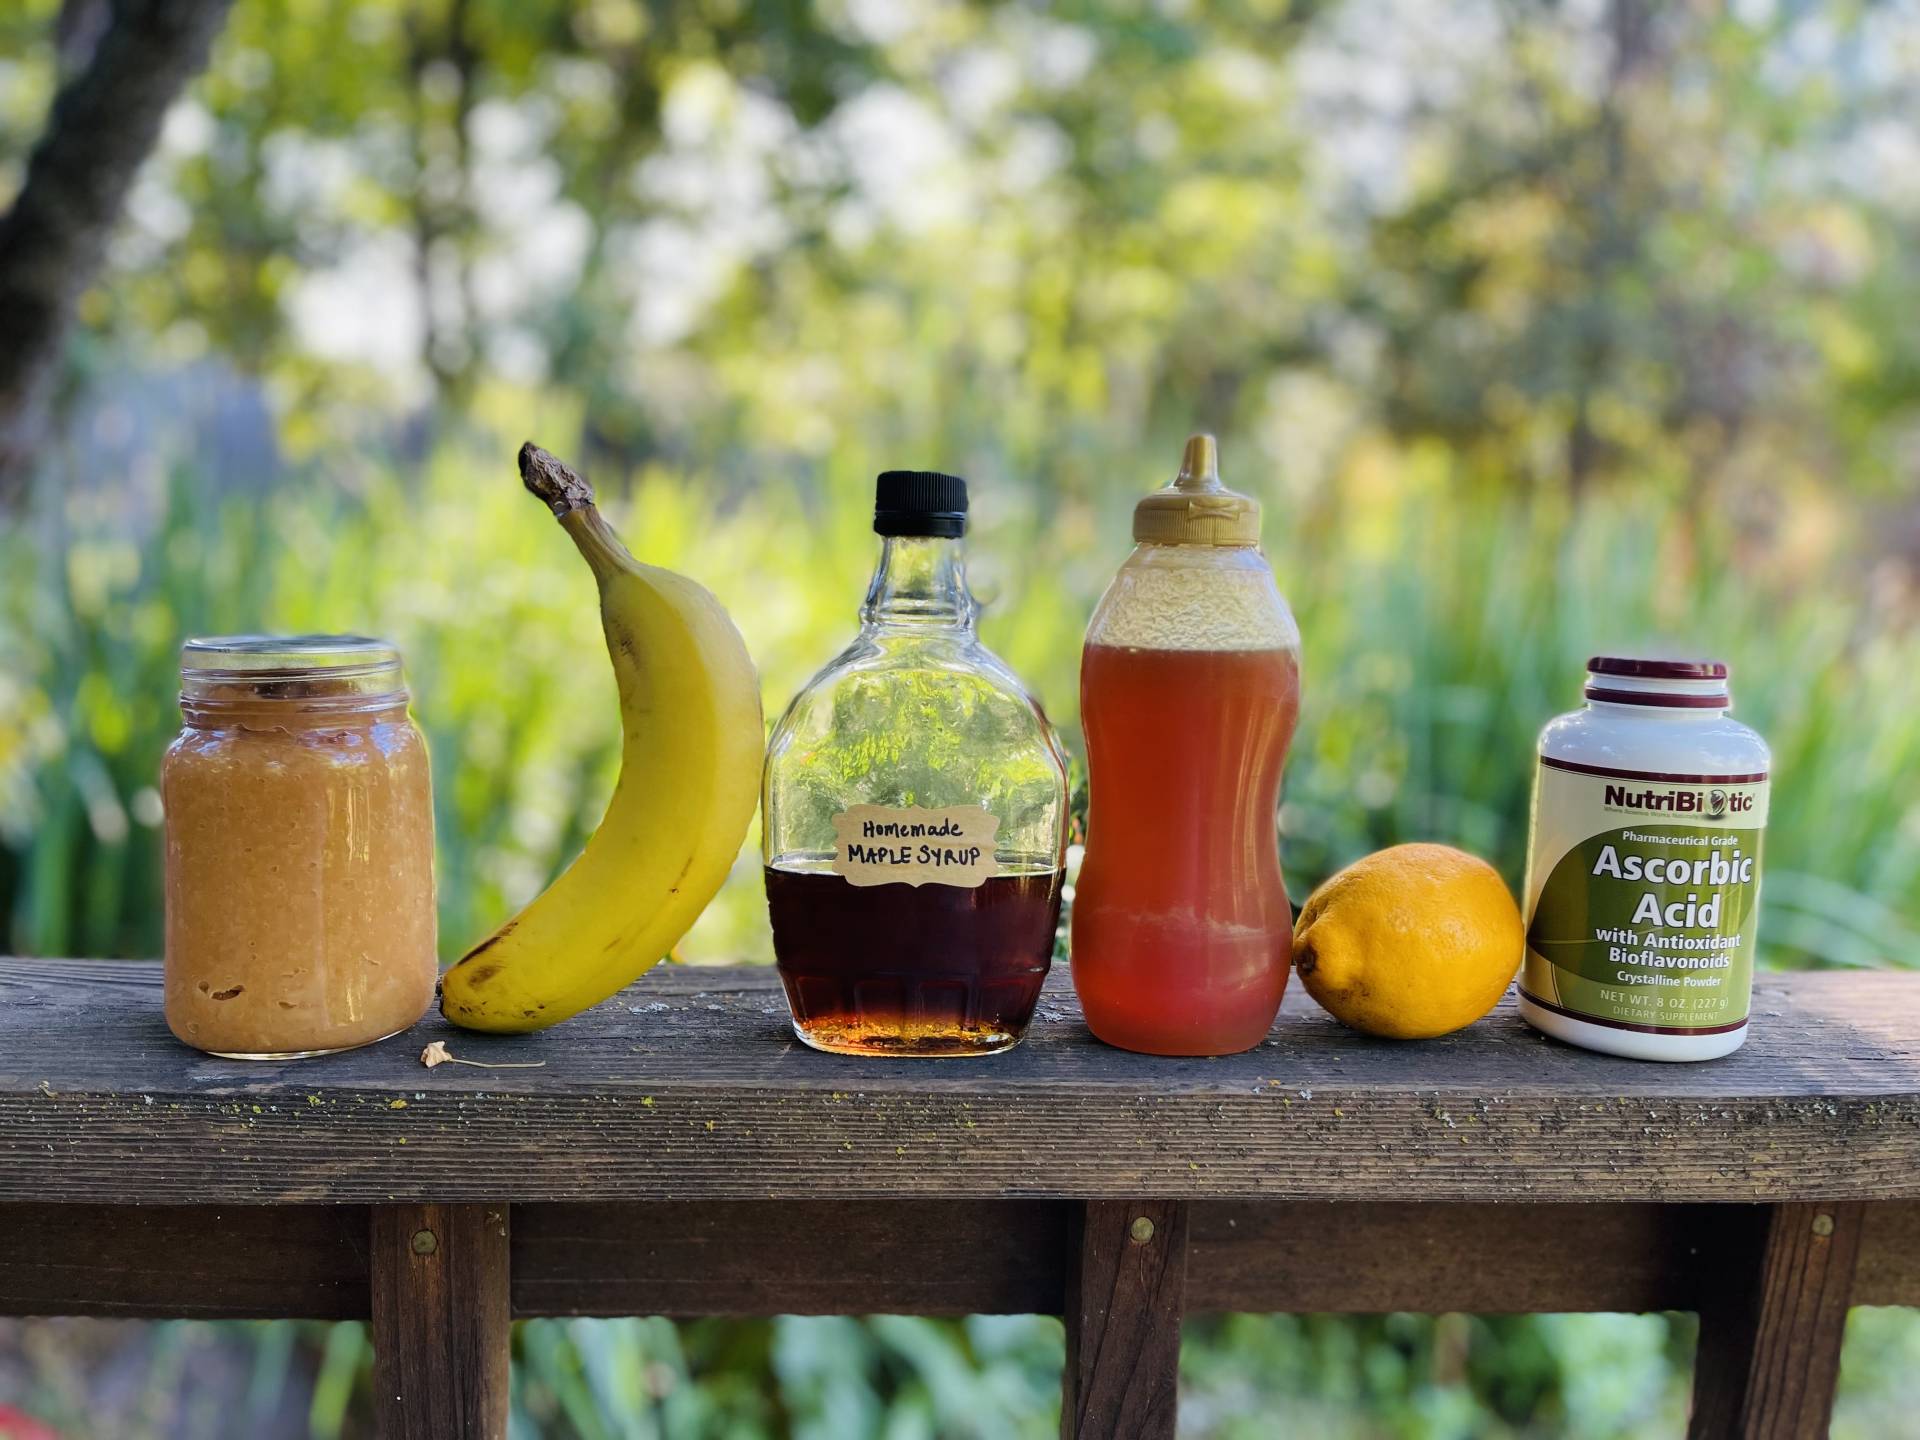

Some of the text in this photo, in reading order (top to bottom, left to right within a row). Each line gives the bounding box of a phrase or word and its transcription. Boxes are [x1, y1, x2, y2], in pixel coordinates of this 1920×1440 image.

[863, 817, 963, 838] Homemade
[1622, 830, 1739, 846] Pharmaceutical Grade
[848, 844, 981, 866] MAPLE SYRUP
[1591, 844, 1752, 886] Ascorbic
[1630, 892, 1721, 928] Acid
[1596, 928, 1741, 951] with Antioxidant
[1608, 946, 1730, 969] Bioflavonoids
[1616, 970, 1722, 987] Crystalline Powder
[1600, 989, 1625, 1002] NET
[1629, 995, 1652, 1007] WT.
[1656, 997, 1664, 1007] 8
[1669, 998, 1689, 1009] OZ.
[1693, 998, 1716, 1010] (227
[1613, 1006, 1721, 1022] DIETARY SUPPLEMENT
